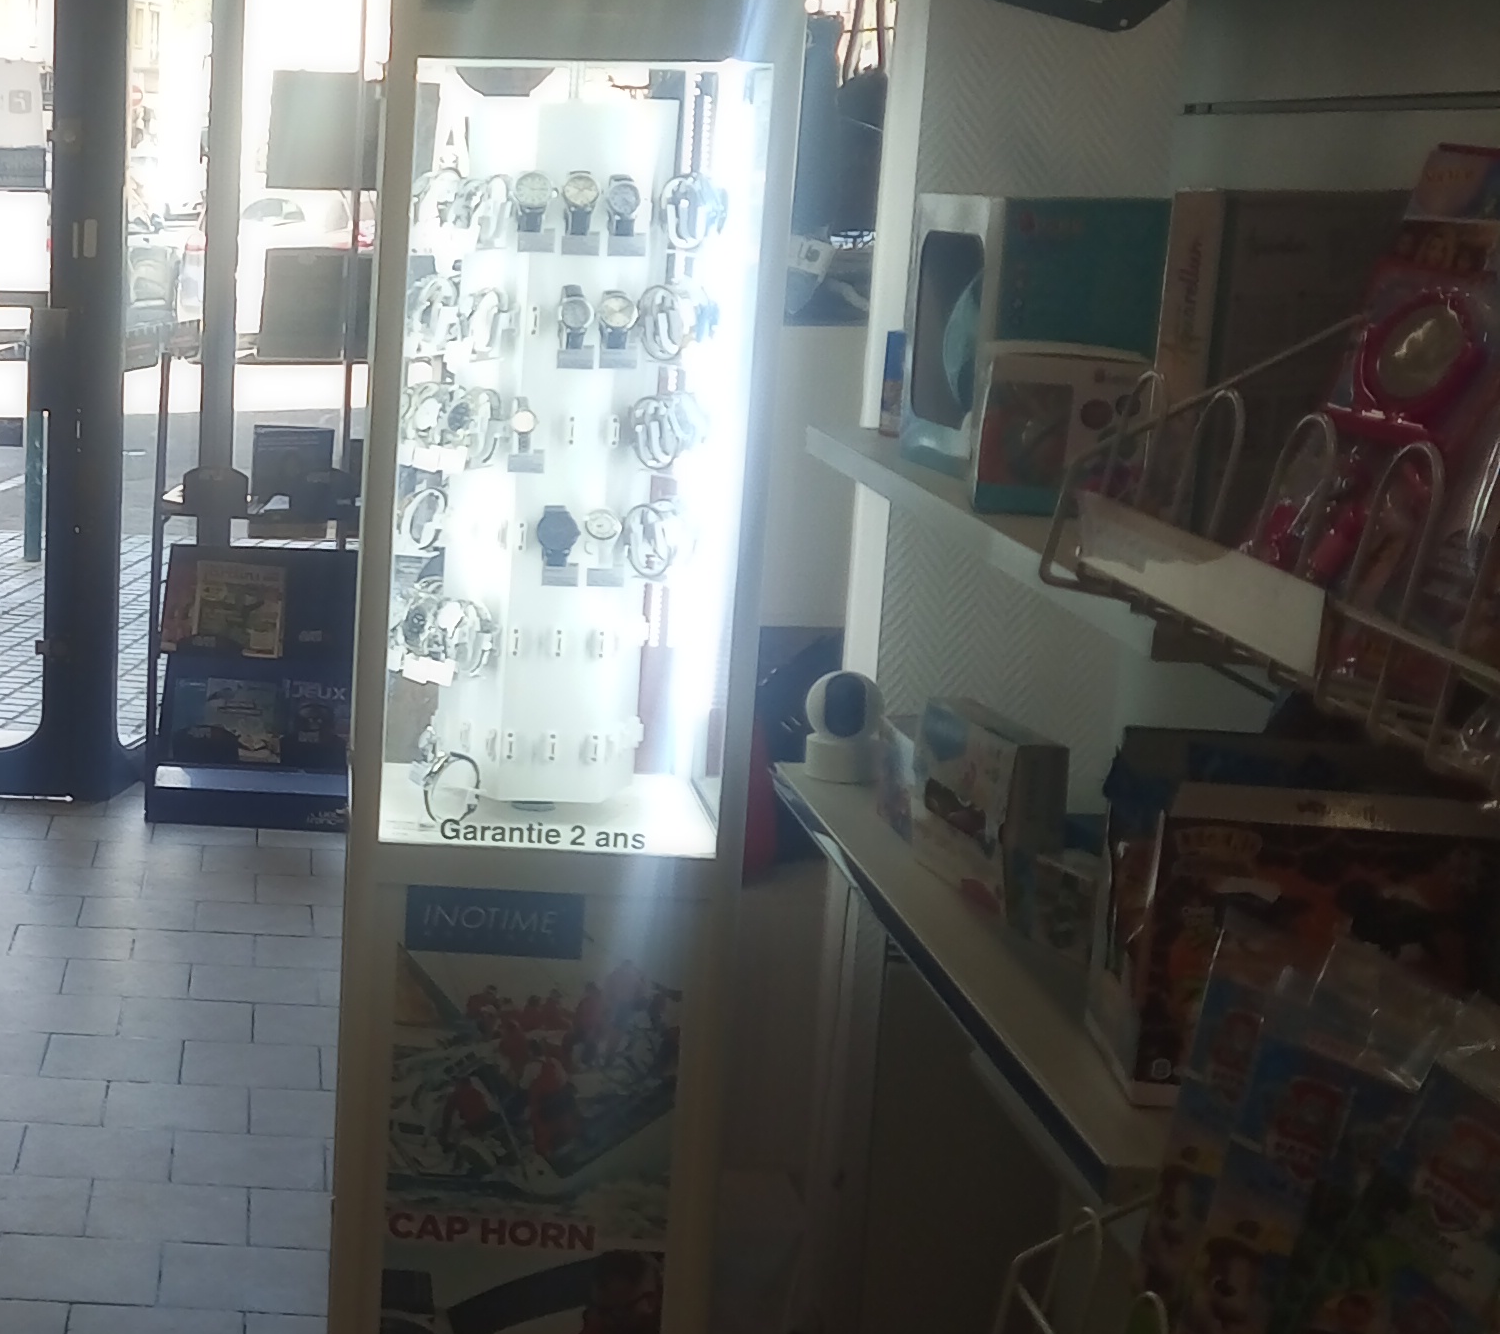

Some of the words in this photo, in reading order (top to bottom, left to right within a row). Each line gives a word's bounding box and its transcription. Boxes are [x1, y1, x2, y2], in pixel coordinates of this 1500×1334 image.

[439, 817, 562, 847] Garantie
[569, 824, 587, 847] 2
[594, 830, 647, 851] ans
[422, 902, 558, 937] INOTIME
[388, 1211, 470, 1245] CAP
[479, 1216, 598, 1252] HORN
